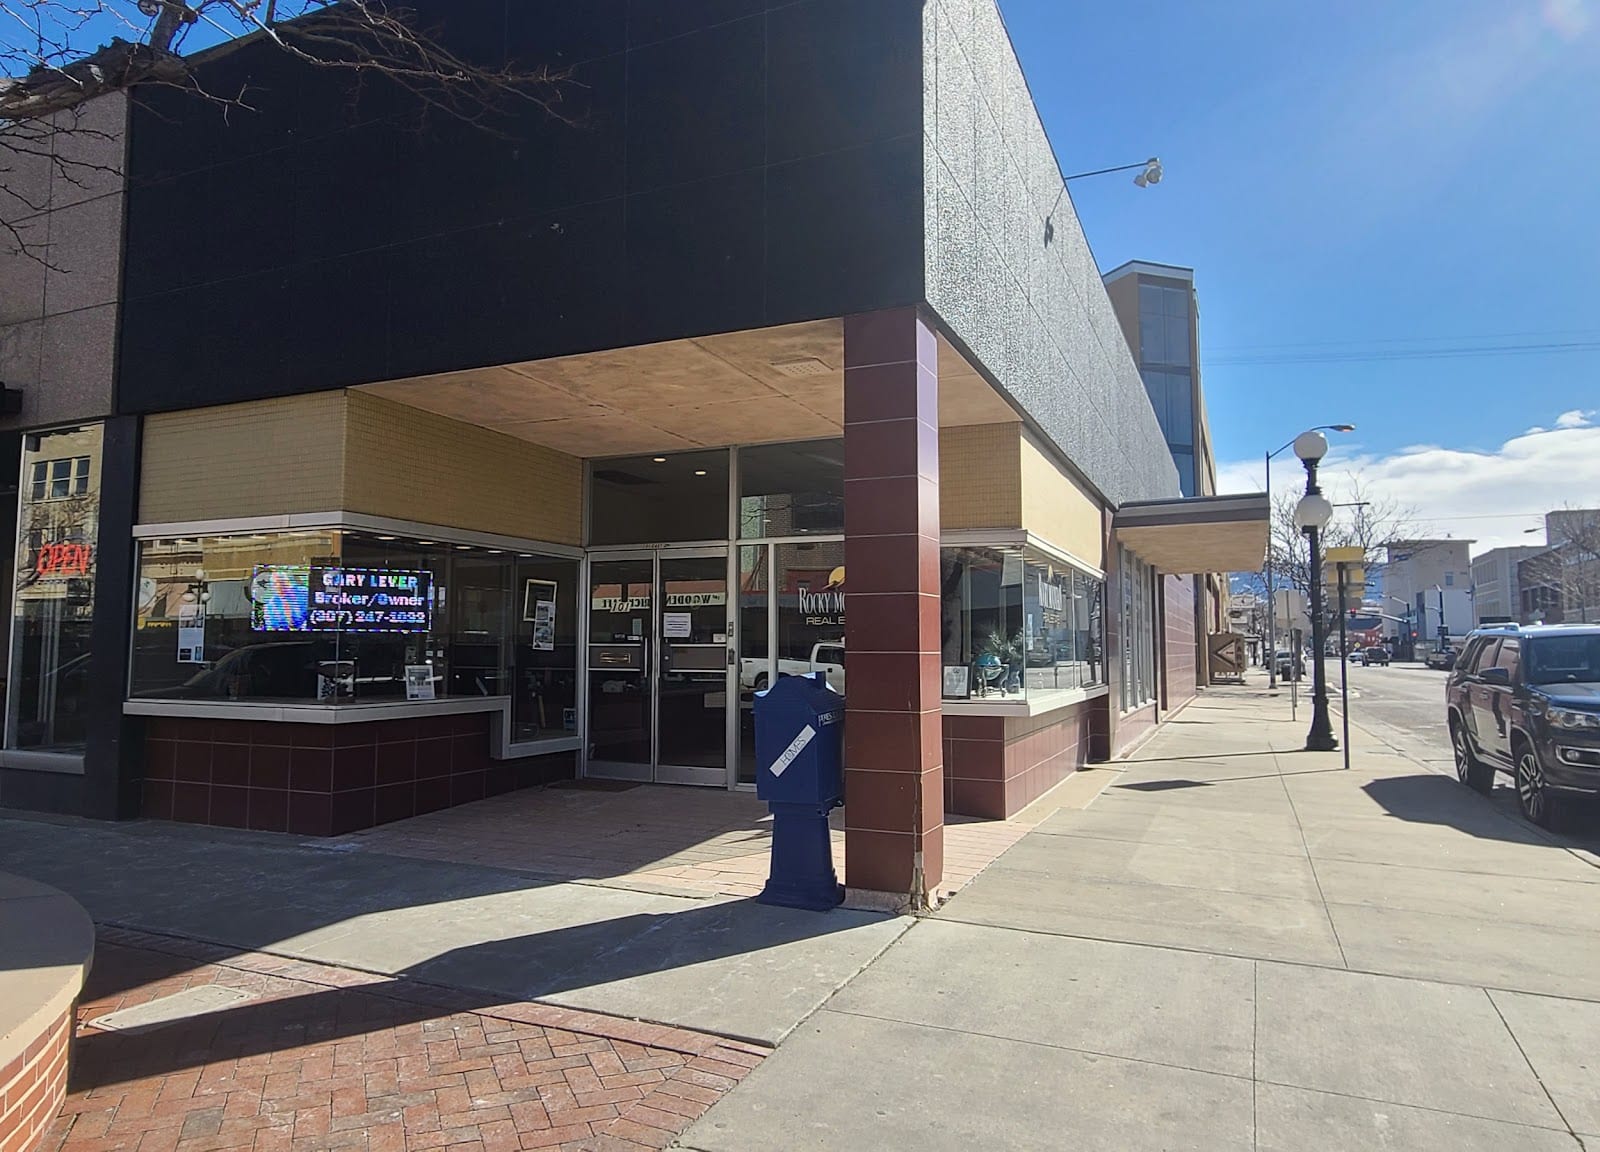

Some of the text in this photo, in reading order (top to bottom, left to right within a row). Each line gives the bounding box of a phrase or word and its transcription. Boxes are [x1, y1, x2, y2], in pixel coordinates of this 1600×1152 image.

[38, 544, 91, 576] OPEN
[322, 574, 366, 587] GARY
[314, 592, 425, 607] Broker/Owner
[799, 587, 831, 615] ROCKY
[310, 610, 353, 625] (307)
[806, 616, 837, 626] REAL
